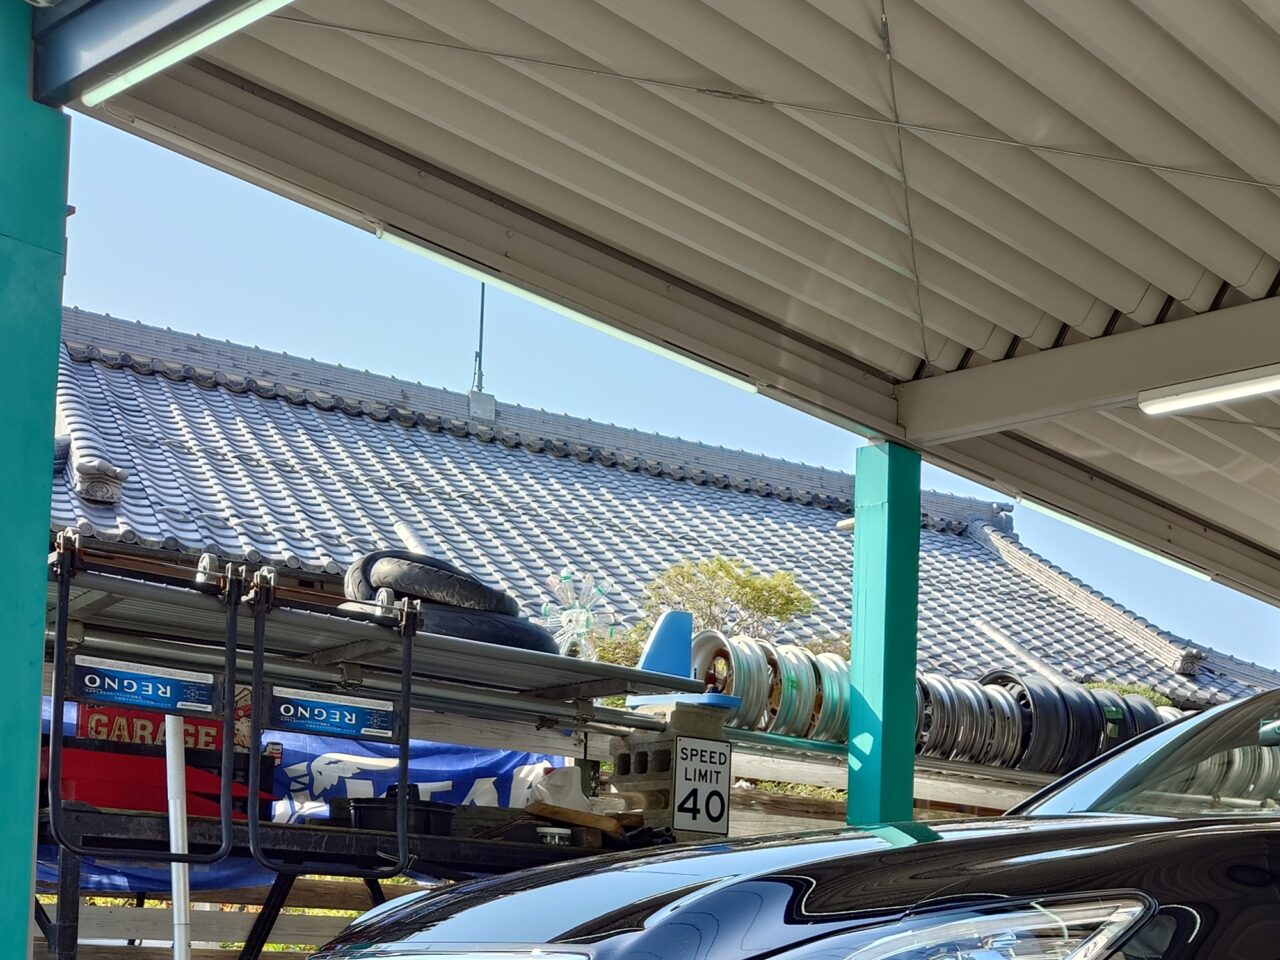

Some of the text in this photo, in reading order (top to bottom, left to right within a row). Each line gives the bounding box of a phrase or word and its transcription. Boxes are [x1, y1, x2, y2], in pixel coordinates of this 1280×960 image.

[84, 674, 171, 698] REGNO
[280, 704, 356, 724] REGNO
[680, 747, 727, 765] SPEED
[684, 767, 721, 784] LIMIT
[677, 787, 725, 823] 40
